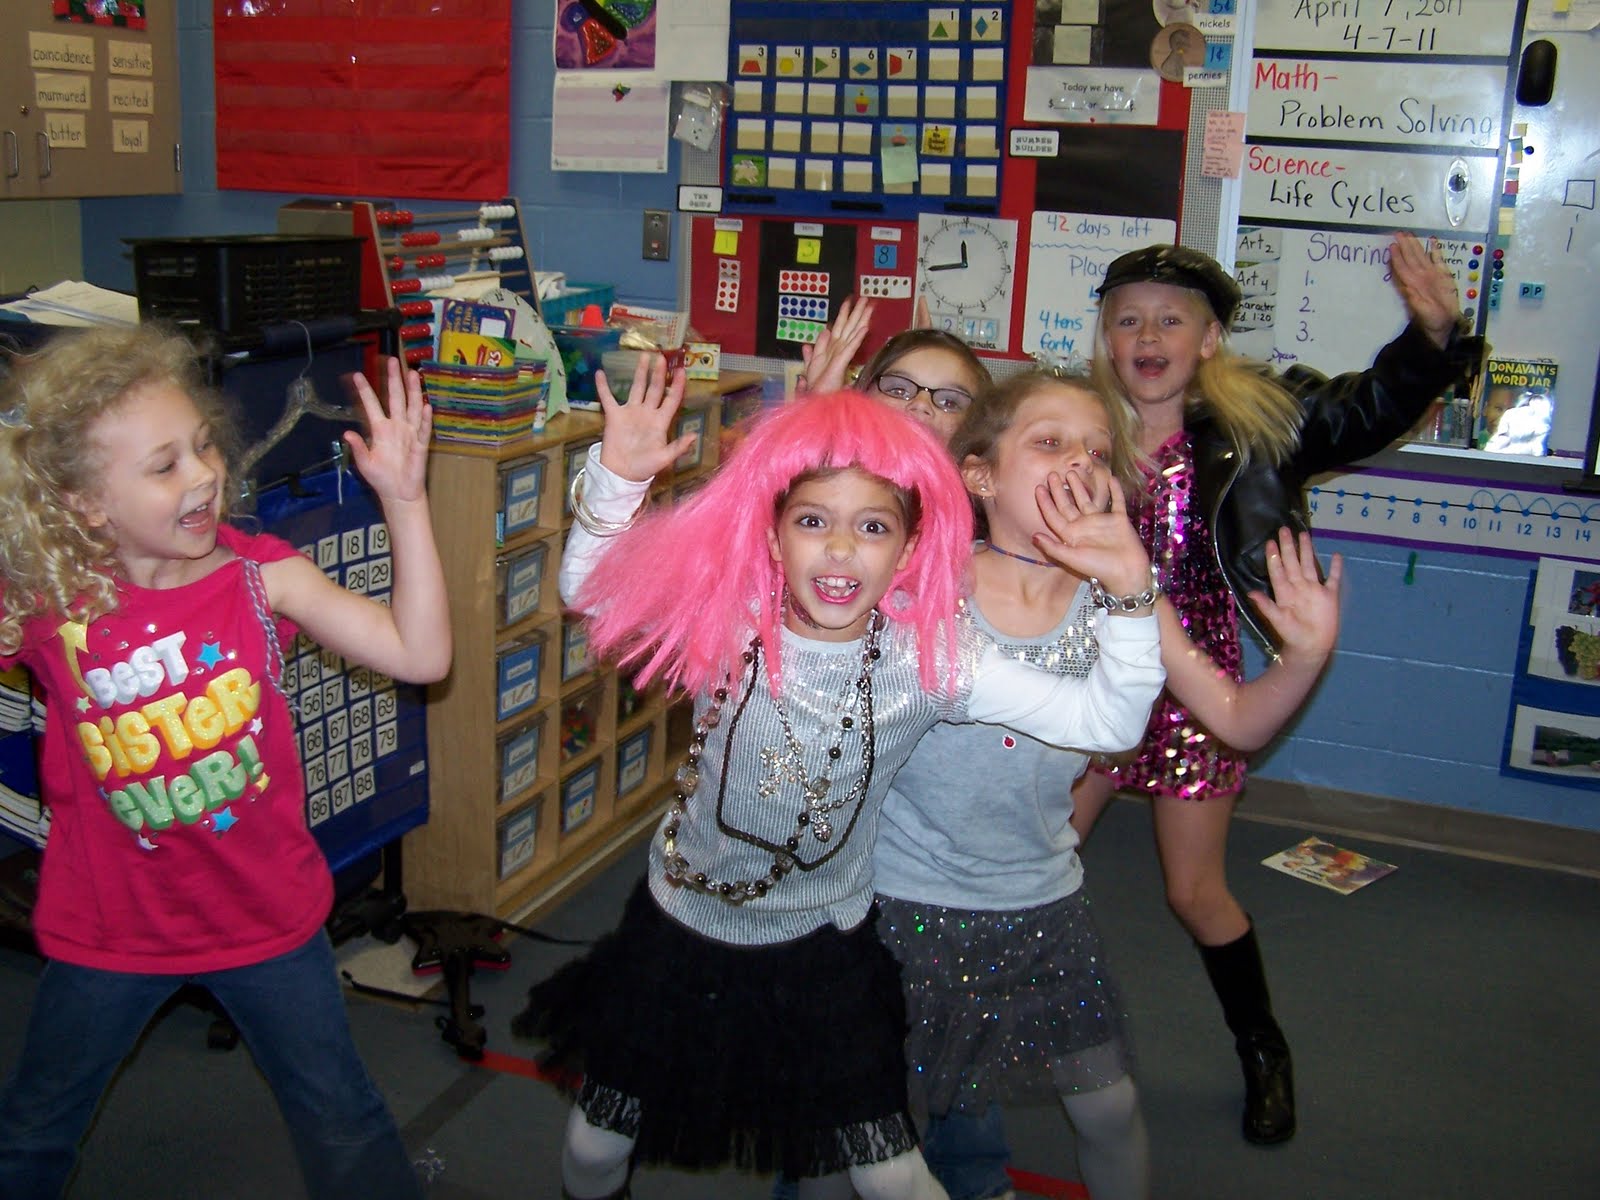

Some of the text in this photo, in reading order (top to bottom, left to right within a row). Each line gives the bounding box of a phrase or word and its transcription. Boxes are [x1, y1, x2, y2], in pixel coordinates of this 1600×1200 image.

[950, 11, 999, 21] 1 2
[1199, 19, 1231, 29] nickels
[1294, 0, 1359, 27] April
[1343, 24, 1436, 50] 4-7-11
[33, 45, 92, 66] coincidence
[112, 53, 152, 70] sensitive
[758, 47, 914, 60] 3 4 5 6 7
[1188, 71, 1222, 82] pennies
[38, 87, 87, 105] murmured
[113, 90, 149, 107] recited
[1062, 82, 1125, 94] Today we have
[50, 122, 81, 142] bitter
[1279, 98, 1493, 146] Problem Solving
[121, 130, 143, 151] loyal
[1269, 180, 1416, 220] Life Cycles
[1047, 214, 1152, 239] 42 days left
[1238, 233, 1264, 252] Art
[878, 245, 889, 265] 8
[1307, 232, 1393, 283] Sharing
[1069, 255, 1109, 278] Plac
[1235, 269, 1268, 291] Art 4
[1299, 296, 1315, 314] 2.
[1040, 310, 1083, 334] 4 tens
[1253, 312, 1272, 322] 1:20
[1039, 332, 1075, 354] forty
[1295, 321, 1315, 343] 3.
[1528, 376, 1552, 389] JAR
[1311, 501, 1592, 542] 4 5 6 7 8 9 10 11 12 13 14
[321, 541, 334, 565] 17
[346, 535, 360, 556] 18
[373, 529, 386, 549] 19
[348, 563, 388, 590] 28 29
[301, 659, 318, 680] 46
[304, 693, 320, 716] 56
[326, 682, 341, 706] 57
[351, 672, 368, 693] 58
[307, 696, 394, 752] 66 67 68 69
[308, 728, 394, 787] 76 77 78 79
[311, 772, 373, 820] 86 87 88
